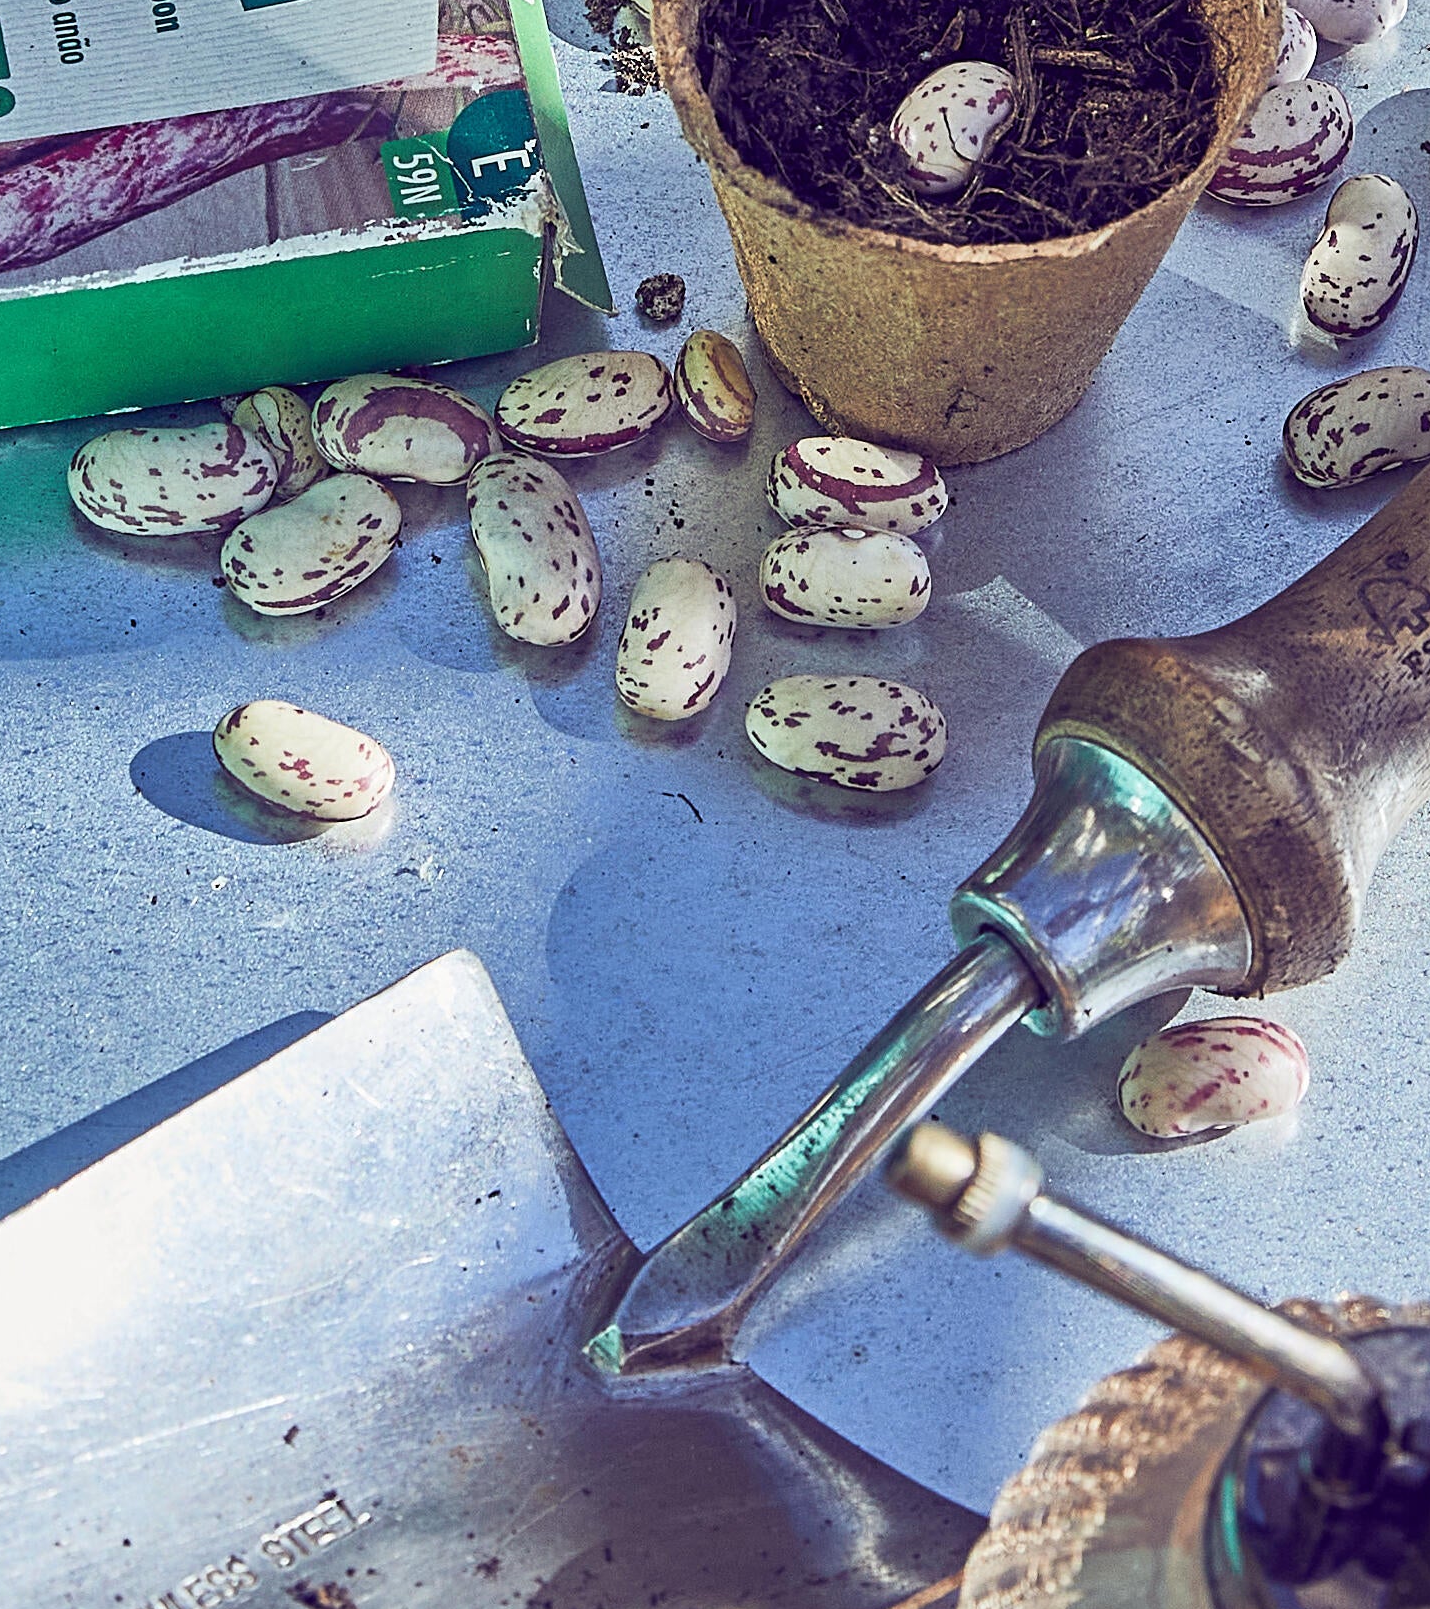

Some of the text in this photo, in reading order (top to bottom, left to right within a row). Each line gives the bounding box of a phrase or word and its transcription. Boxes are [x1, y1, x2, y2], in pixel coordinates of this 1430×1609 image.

[52, 11, 91, 65] anão
[393, 152, 442, 206] 59N
[471, 148, 532, 178] E
[260, 1499, 372, 1569] STEEL
